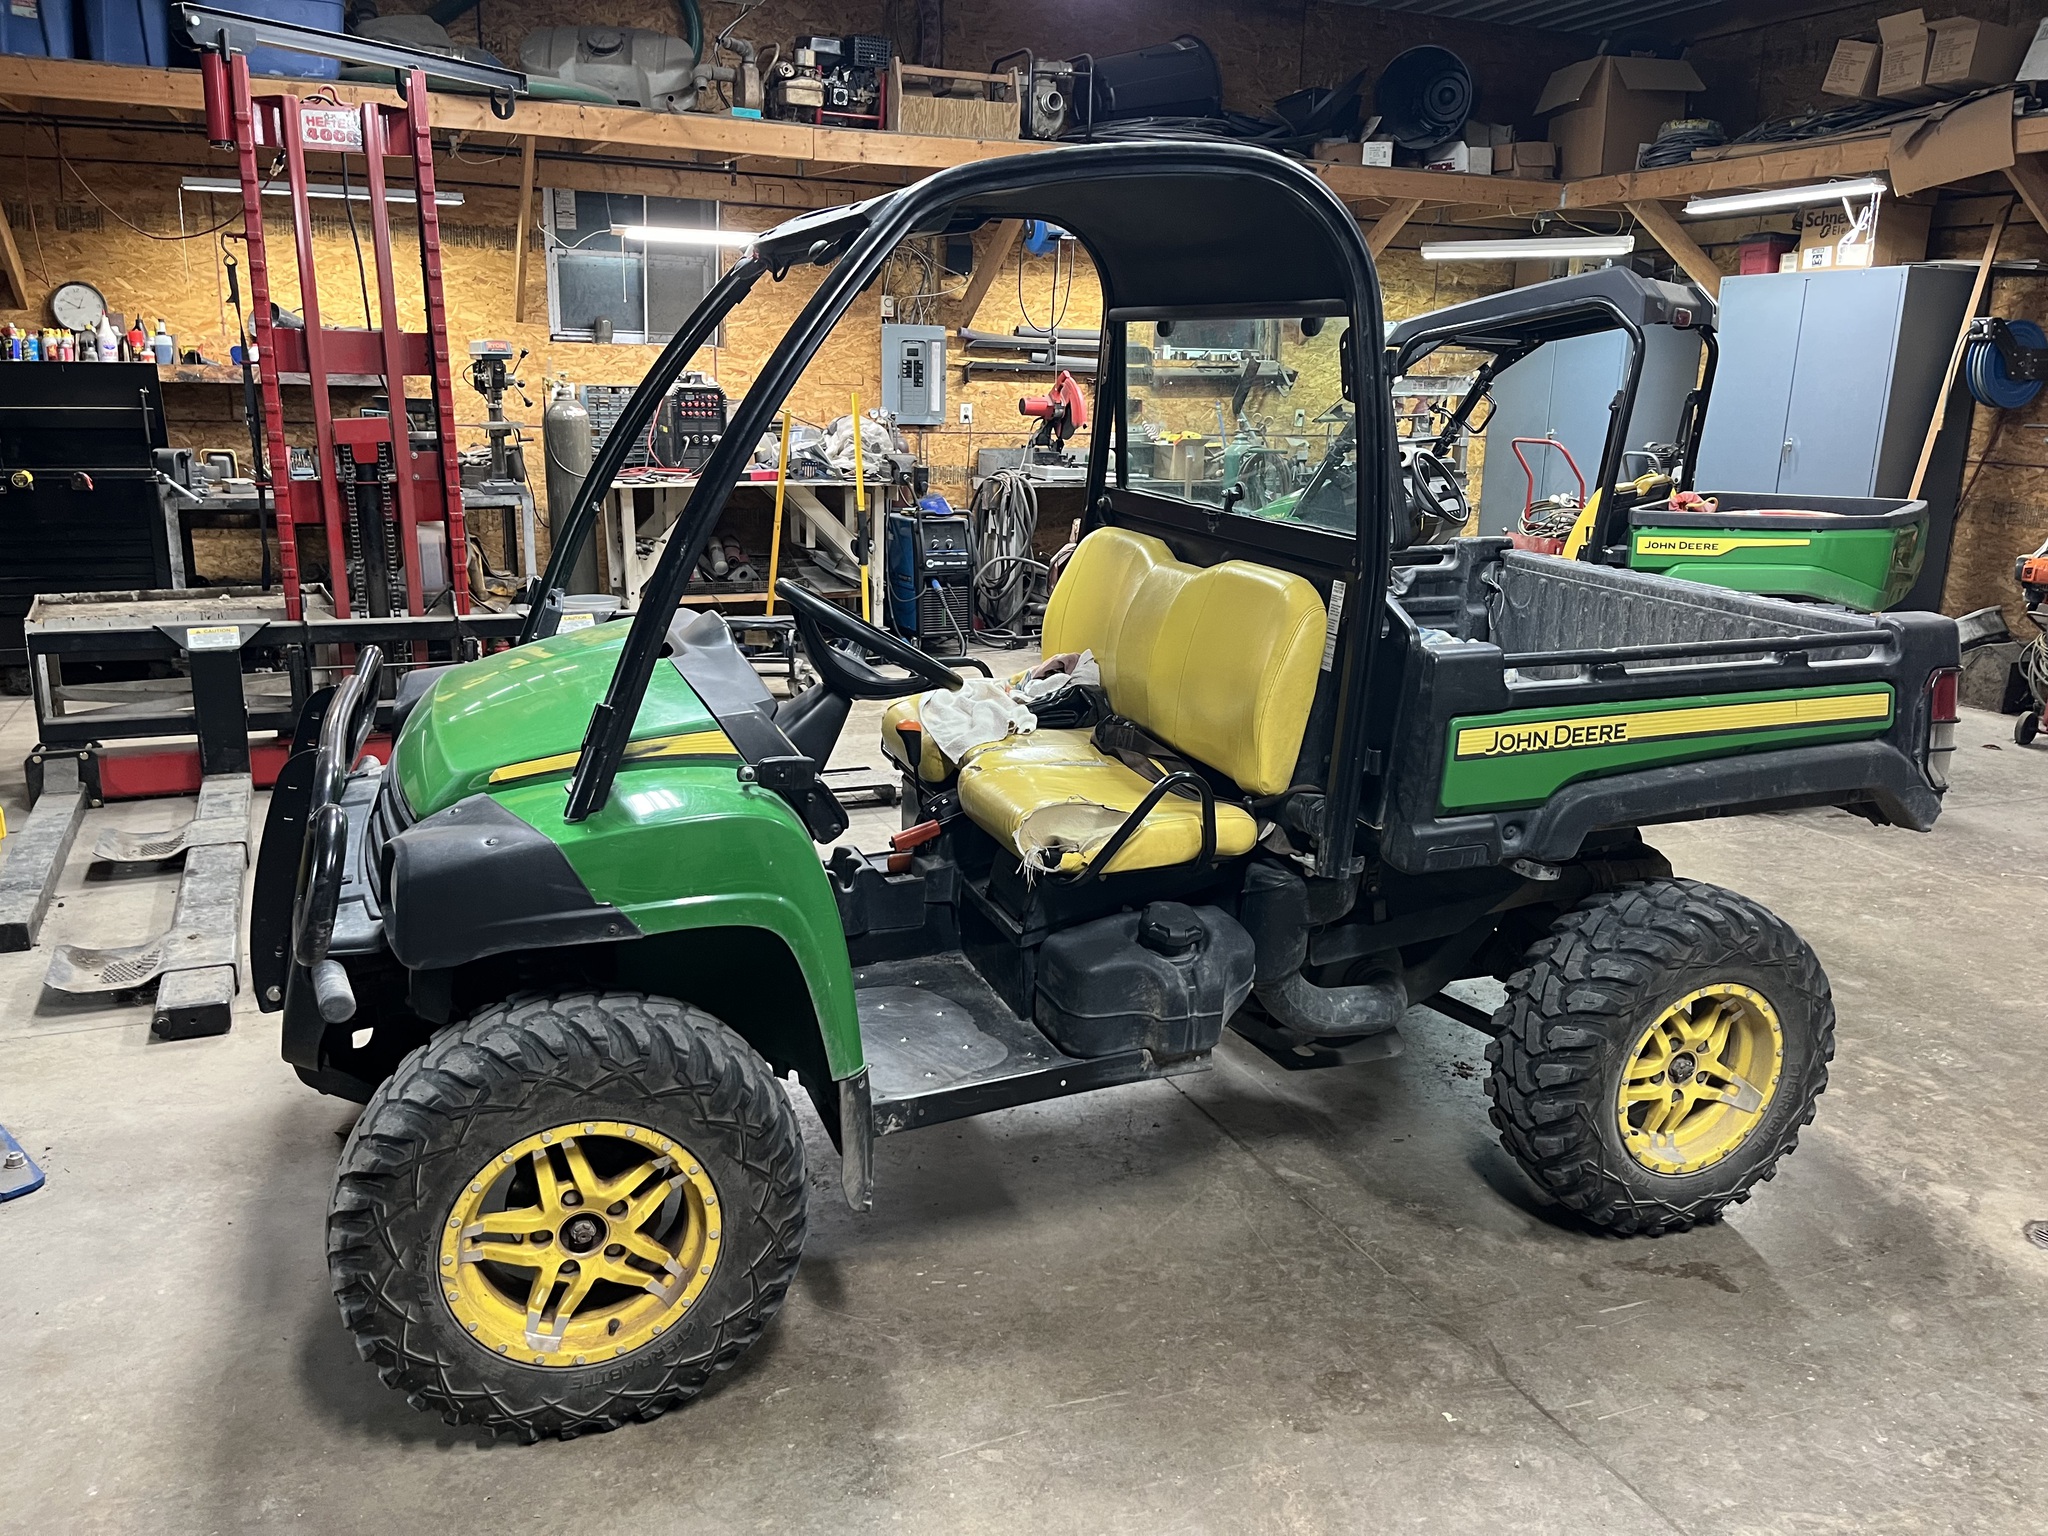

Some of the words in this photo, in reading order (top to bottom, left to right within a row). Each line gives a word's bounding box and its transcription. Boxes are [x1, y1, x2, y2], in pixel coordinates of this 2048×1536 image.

[1645, 541, 1676, 549] JOHN
[1679, 541, 1719, 550] DEERE
[1485, 730, 1549, 753] JOHN
[1554, 722, 1628, 746] DEERE
